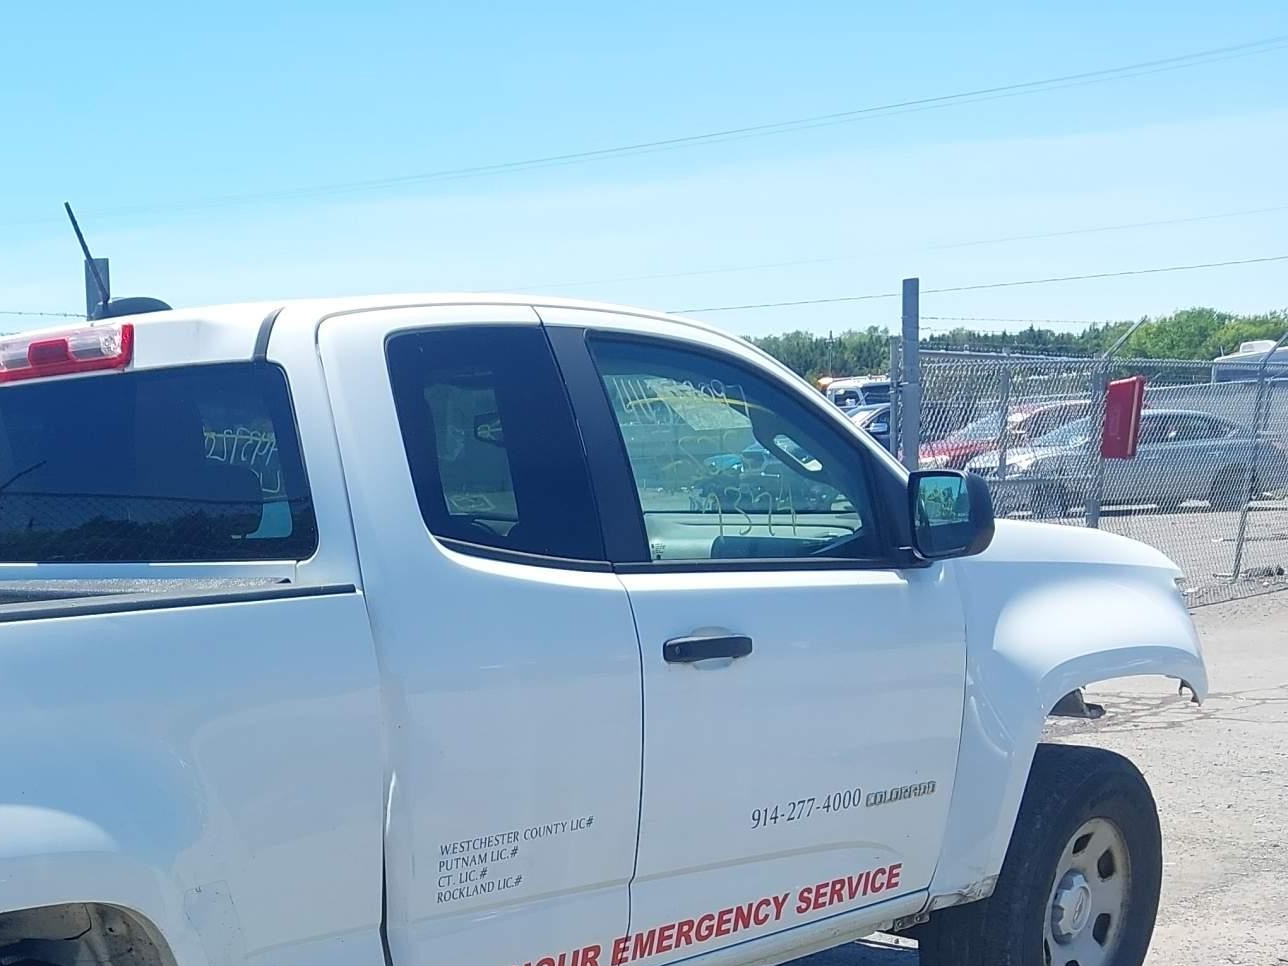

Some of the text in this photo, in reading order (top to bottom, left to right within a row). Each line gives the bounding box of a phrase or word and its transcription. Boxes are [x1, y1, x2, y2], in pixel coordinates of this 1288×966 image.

[751, 787, 862, 830] 914-277-4000
[865, 780, 937, 808] COLORADO
[439, 815, 595, 857] WESTCHESTER COUNTY LIC#
[438, 845, 520, 873] PUTNAM LIC.#
[436, 874, 523, 904] ROCKLAND LIC.#
[437, 866, 489, 888] CT. LIC.#
[610, 892, 791, 966] EMERGENCY
[795, 863, 903, 914] SERVICE
